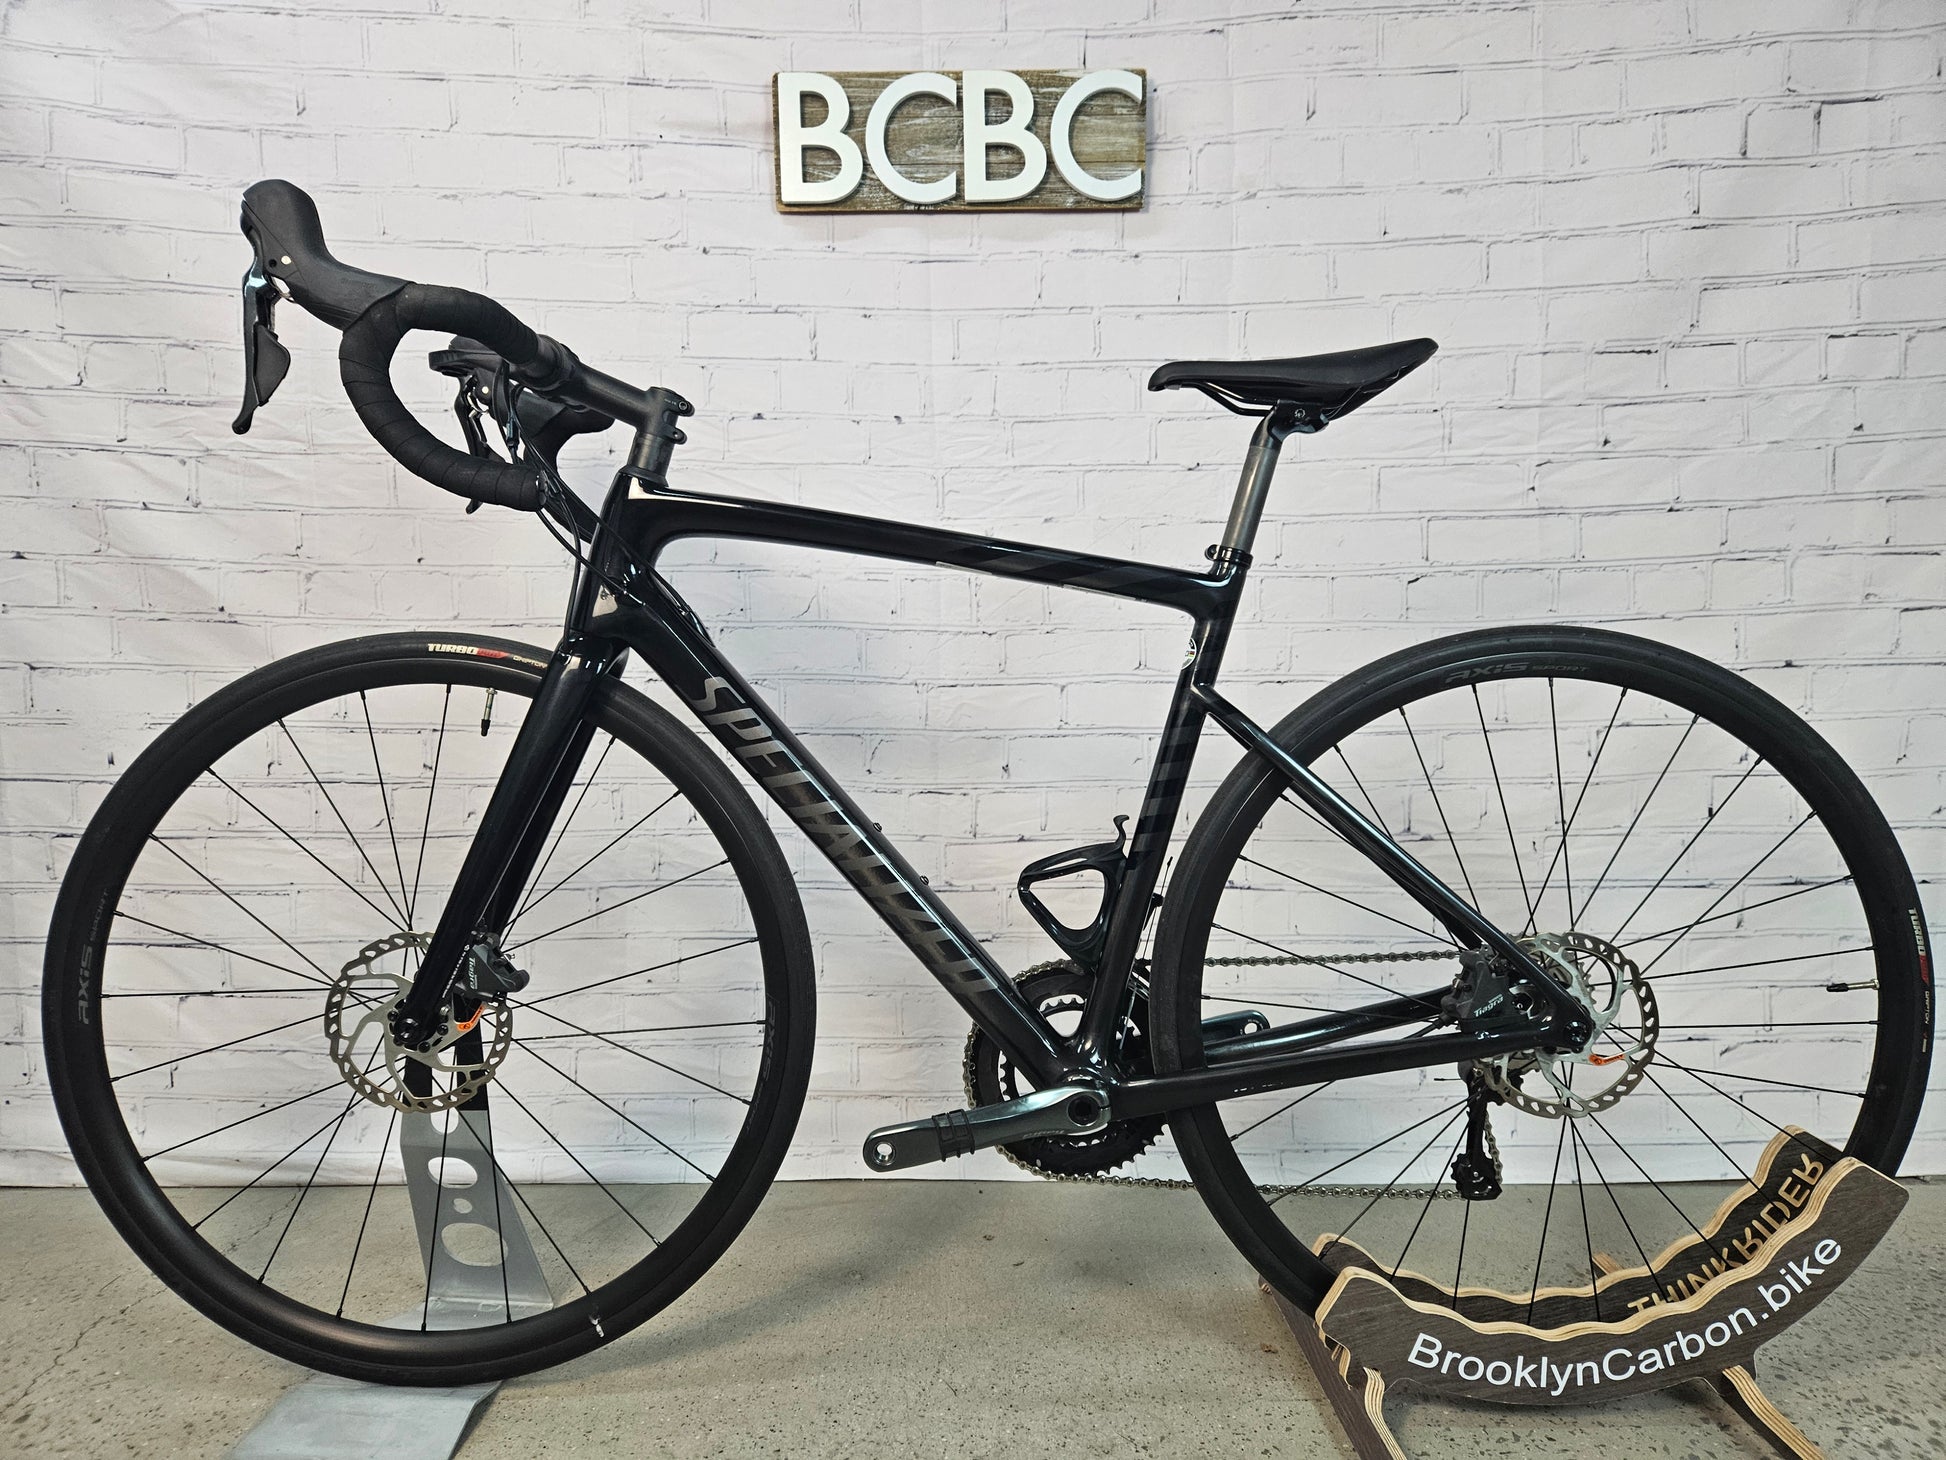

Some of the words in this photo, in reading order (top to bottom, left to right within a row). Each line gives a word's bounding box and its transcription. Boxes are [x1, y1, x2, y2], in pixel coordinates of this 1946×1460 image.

[777, 69, 1143, 205] BCBC
[428, 643, 479, 656] TURBO
[688, 676, 999, 1000] SPECIALIZED
[1908, 907, 1926, 957] TURBO
[1473, 996, 1504, 1018] Tiagra
[1407, 1238, 1842, 1397] BrooklynCarbon.bike
